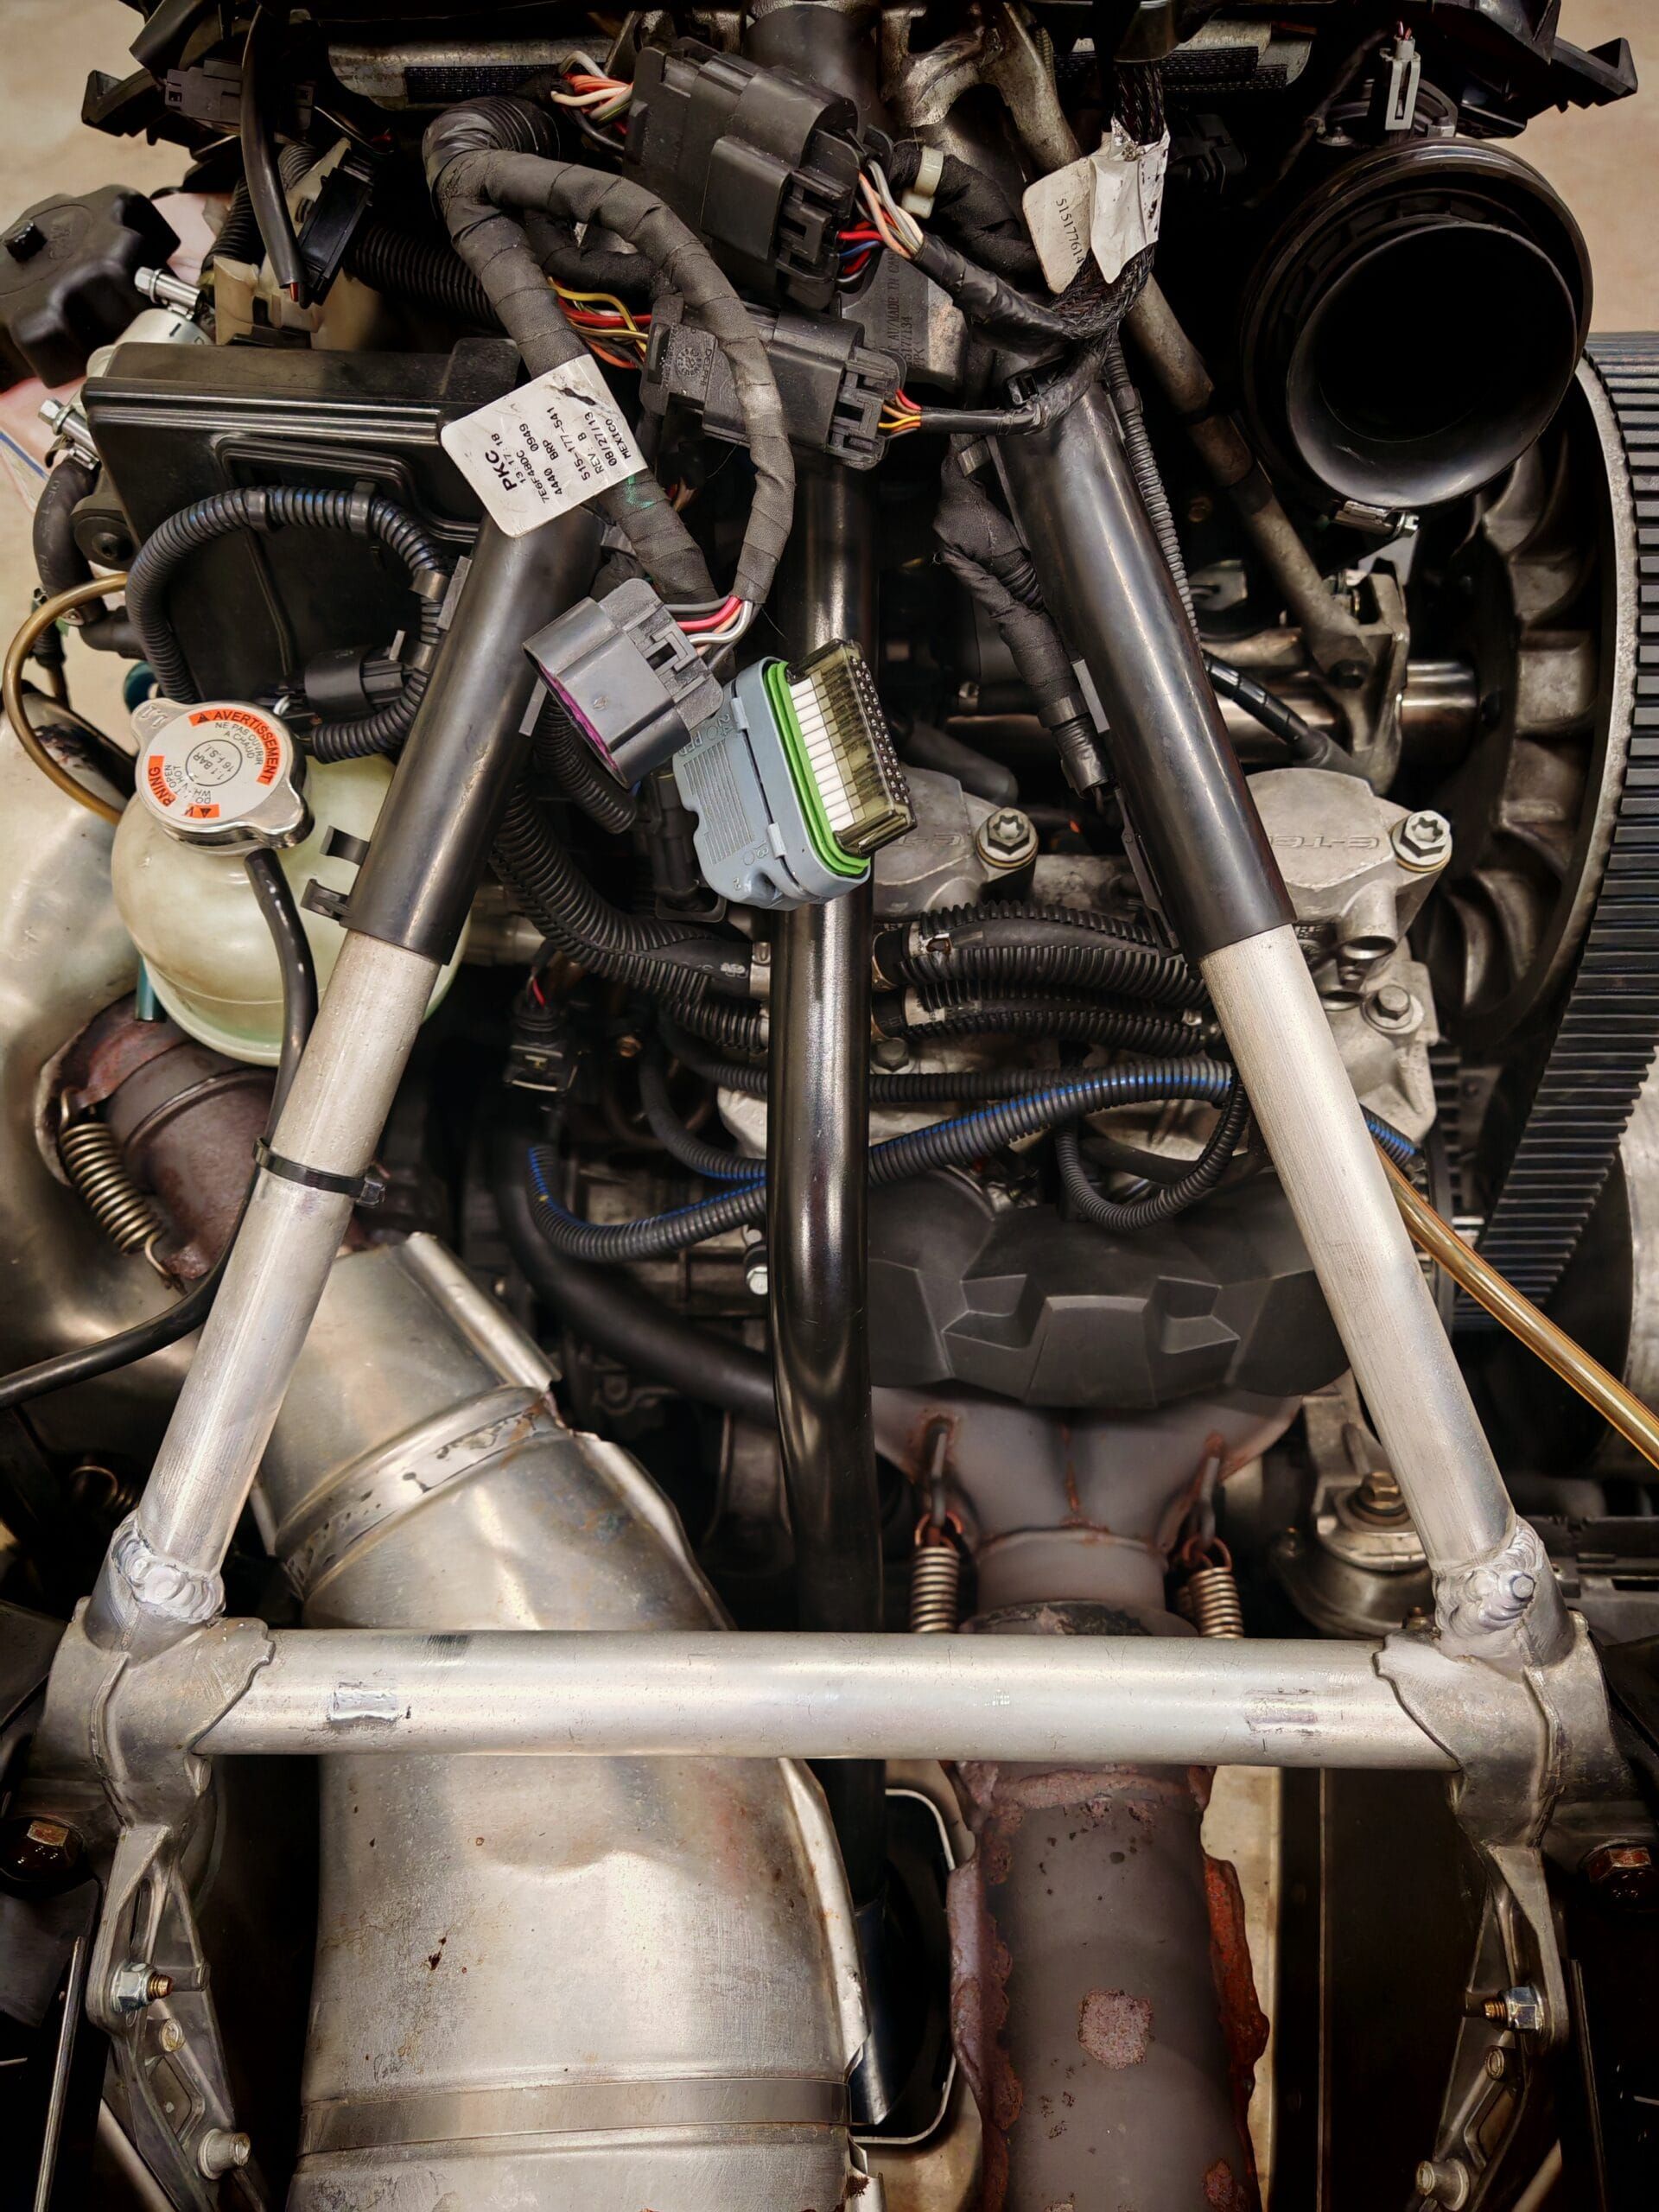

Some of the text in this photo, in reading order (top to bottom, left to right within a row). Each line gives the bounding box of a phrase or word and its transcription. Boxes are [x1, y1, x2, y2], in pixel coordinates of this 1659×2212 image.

[1056, 199, 1084, 264] 515177614
[700, 348, 713, 385] DELPHI
[542, 437, 559, 461] BRP
[546, 406, 591, 481] 515-177-541
[577, 431, 604, 474] REV: B
[584, 410, 618, 467] 08/27/13
[605, 417, 632, 460] MEXICO
[484, 448, 518, 492] PKC
[518, 423, 563, 496] 4440 0949
[213, 711, 280, 784] AVERTISSEMENT
[231, 724, 249, 735] PAS
[232, 734, 255, 759] CHAUD
[165, 765, 177, 788] OPEN
[173, 766, 184, 785] HOT
[194, 752, 213, 771] BAR
[1270, 835, 1381, 849] E-TE
